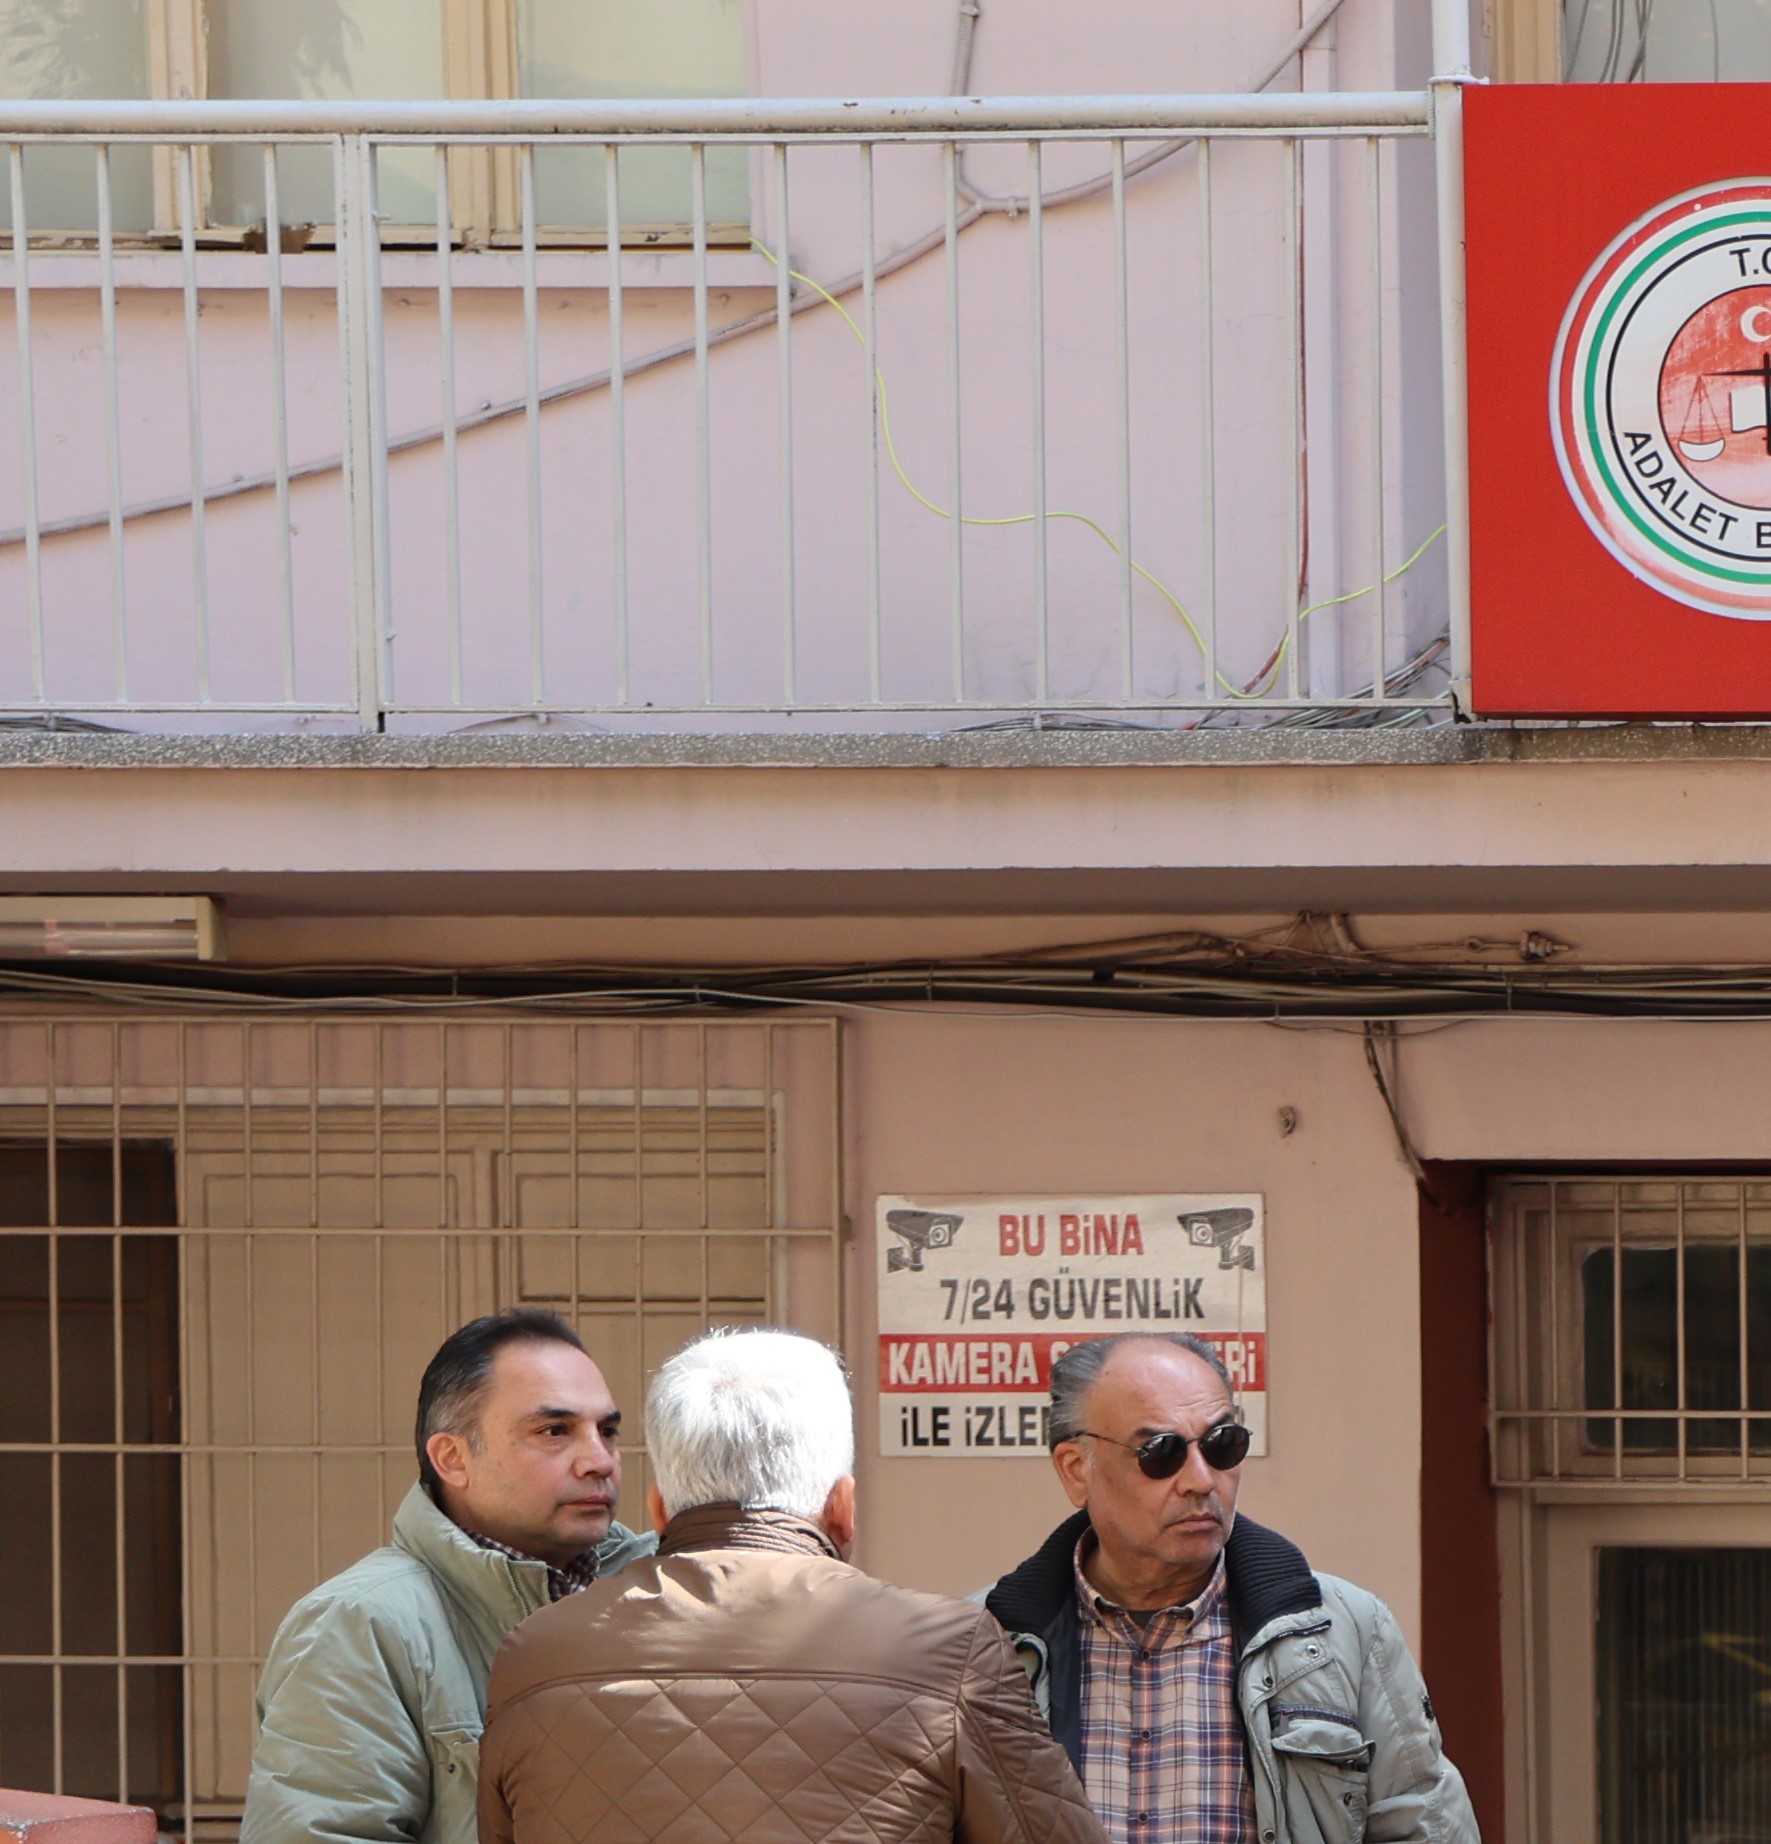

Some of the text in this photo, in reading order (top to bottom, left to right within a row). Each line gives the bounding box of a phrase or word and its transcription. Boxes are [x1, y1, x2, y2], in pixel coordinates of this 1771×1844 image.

[1623, 429, 1739, 542] ADALET
[1000, 1214, 1046, 1257] BU
[939, 1278, 1016, 1324] 7/24
[888, 1341, 1039, 1385] KAMERA
